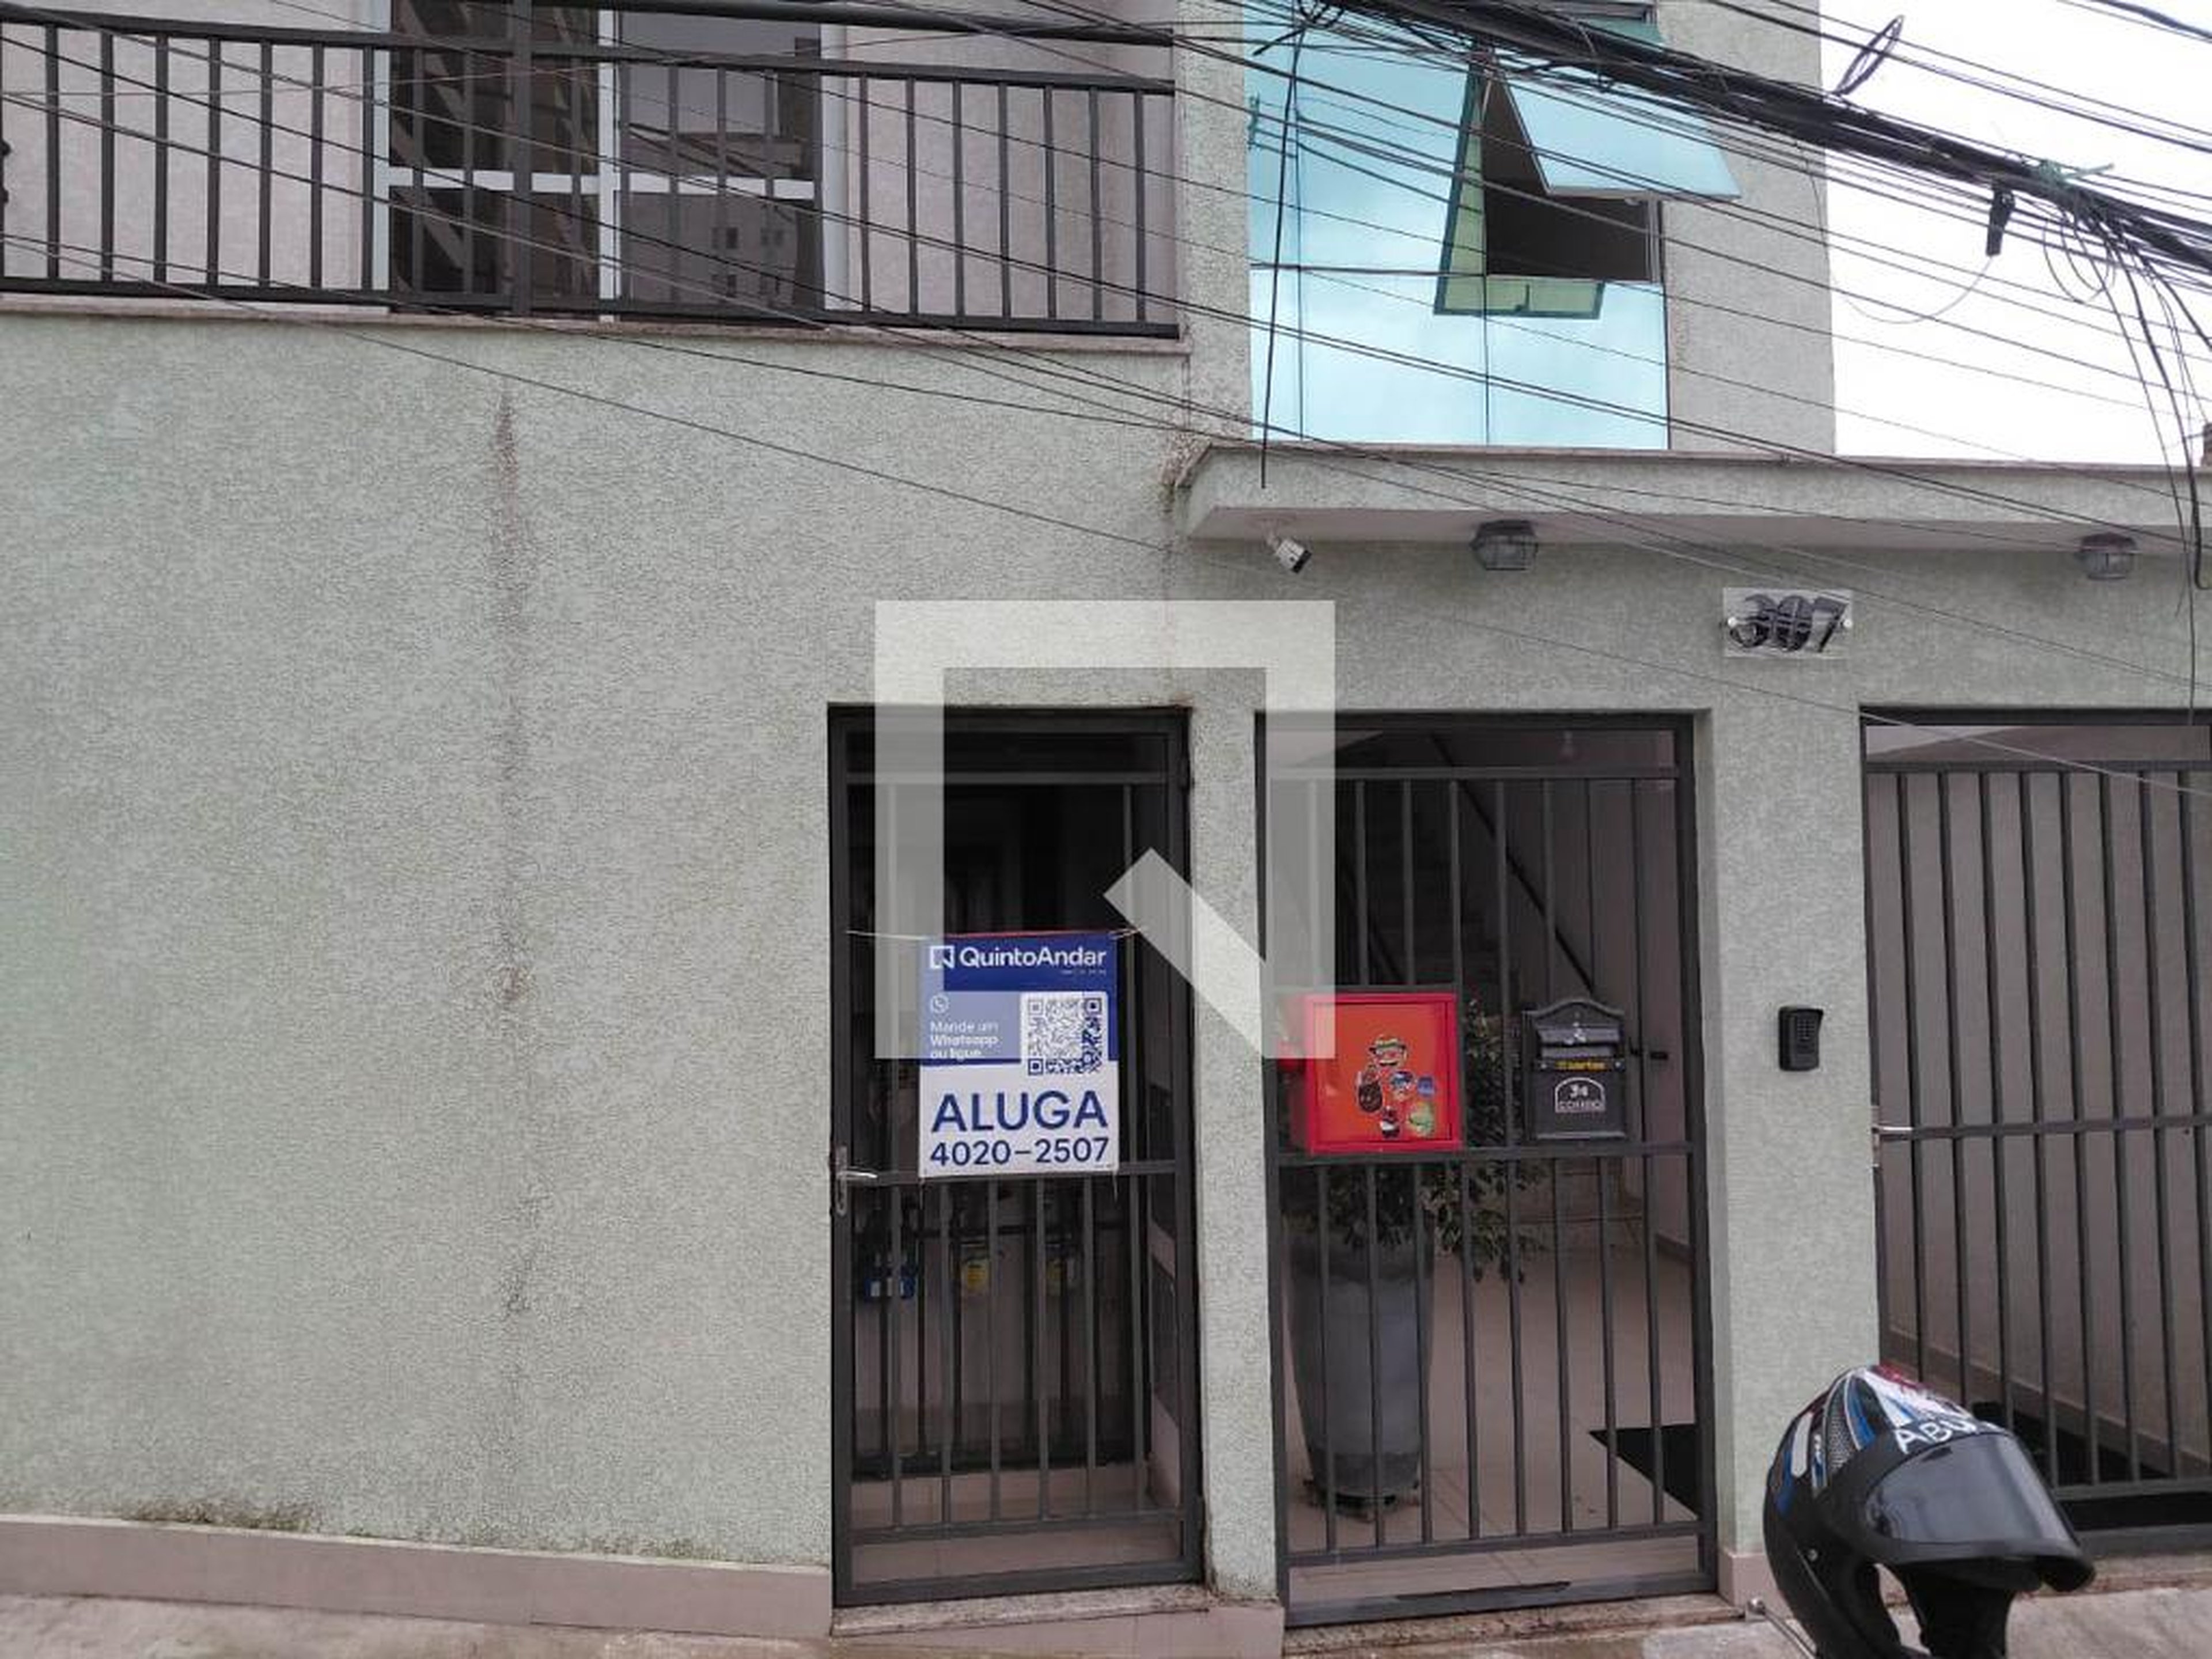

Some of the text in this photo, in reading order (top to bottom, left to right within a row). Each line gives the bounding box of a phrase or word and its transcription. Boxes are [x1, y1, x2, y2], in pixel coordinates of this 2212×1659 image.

[959, 945, 1107, 968] QuintoAndar
[931, 1091, 1108, 1132] ALUGA
[930, 1138, 1109, 1166] 4020-2507
